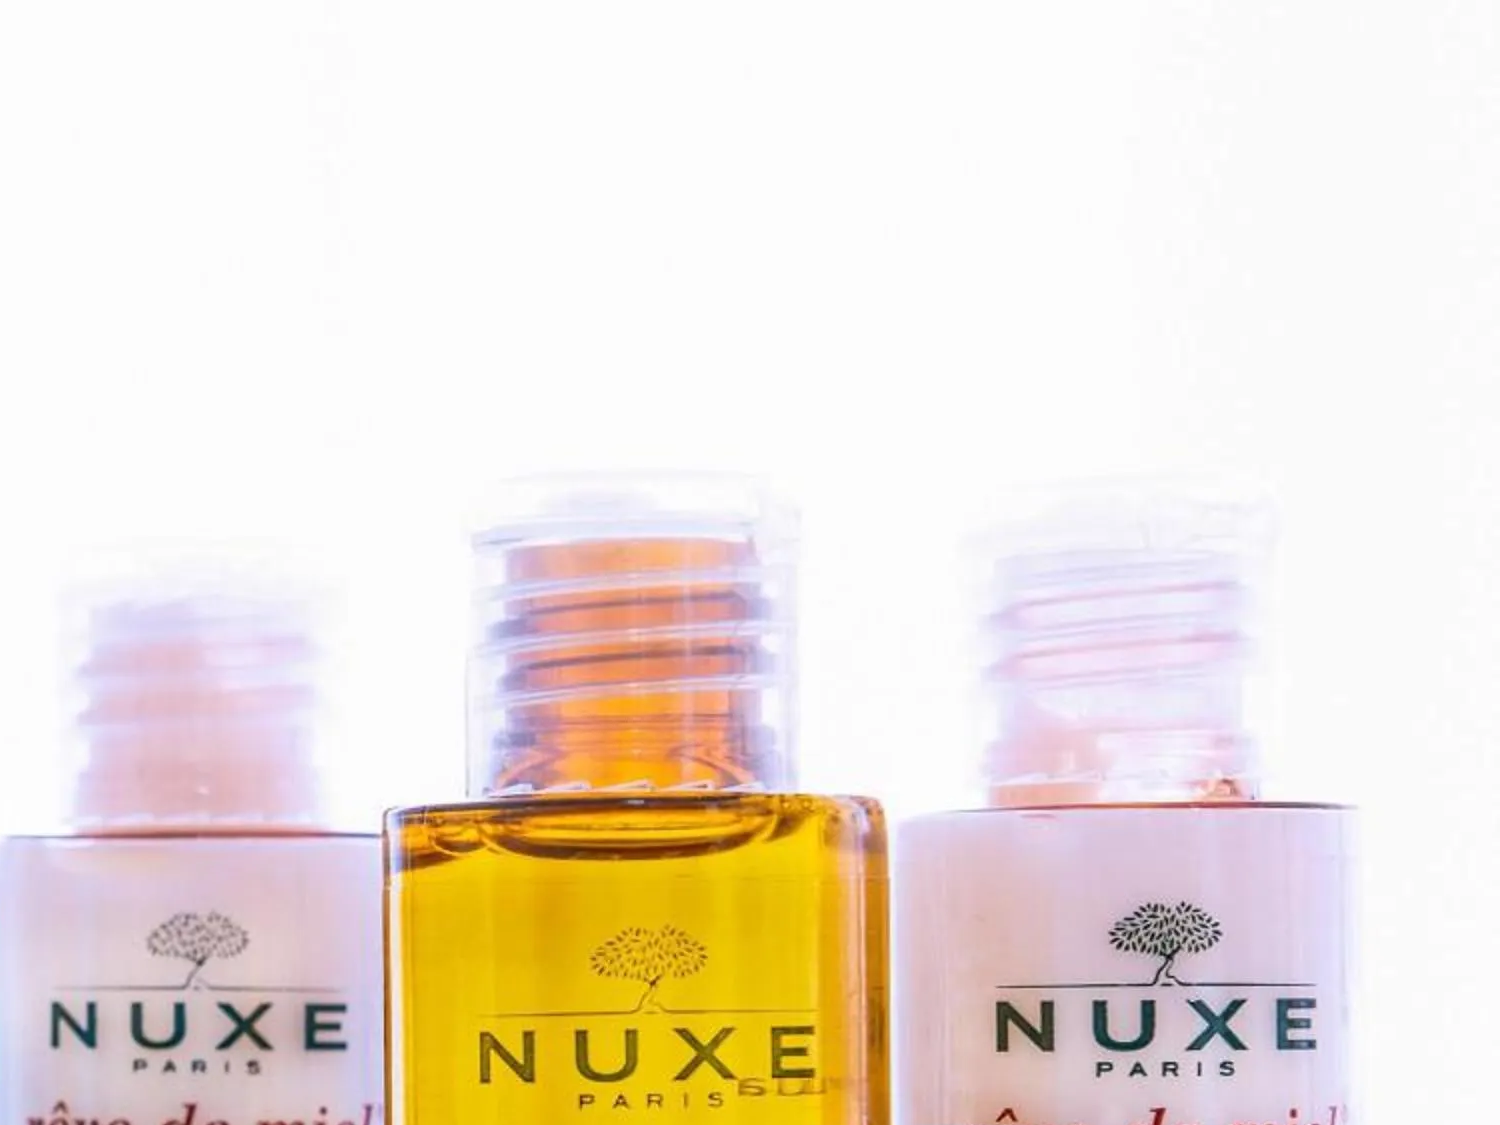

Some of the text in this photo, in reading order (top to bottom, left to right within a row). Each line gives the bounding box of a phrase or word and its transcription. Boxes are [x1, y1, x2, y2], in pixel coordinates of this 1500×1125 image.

[50, 1001, 347, 1051] NUXE
[996, 998, 1317, 1052] NUXE
[132, 1059, 262, 1075] PARIS
[479, 1026, 816, 1084] NUXE
[1096, 1061, 1235, 1078] PARIS
[578, 1092, 724, 1110] PARIS
